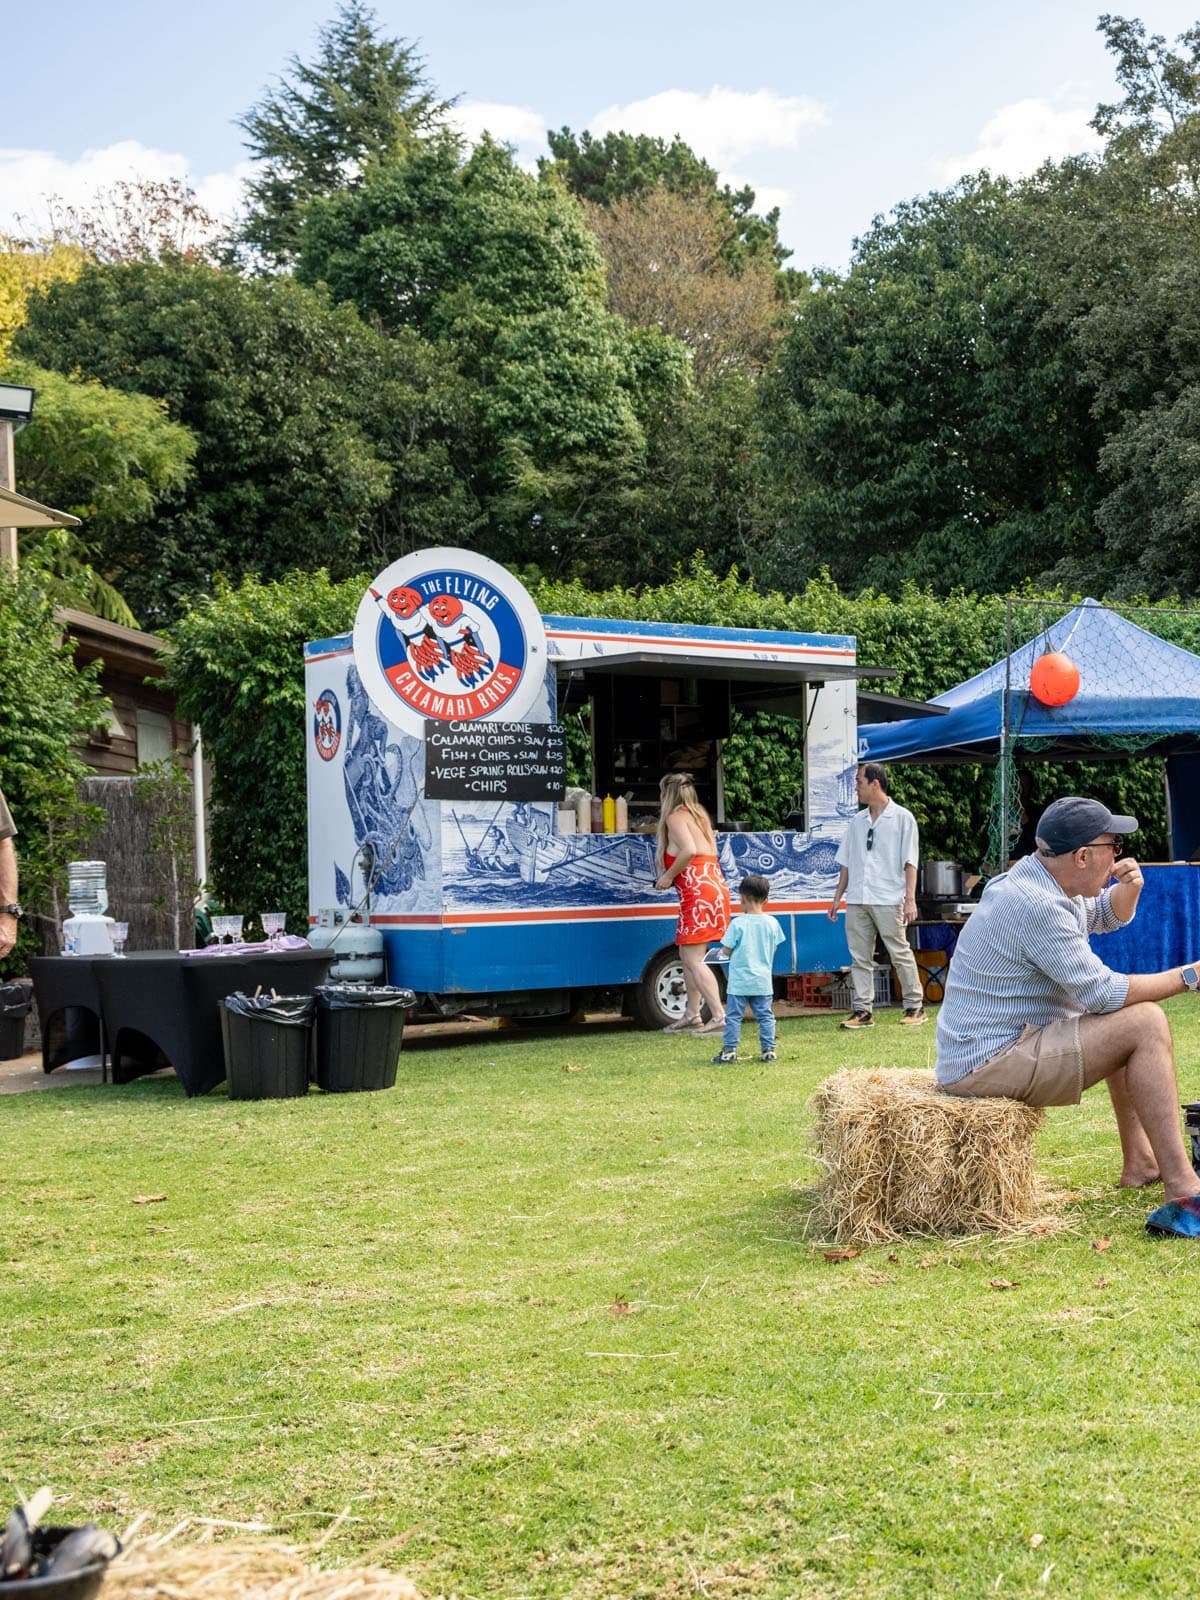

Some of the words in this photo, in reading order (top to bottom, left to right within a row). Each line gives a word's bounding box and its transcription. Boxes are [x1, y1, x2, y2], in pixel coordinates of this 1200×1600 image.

[421, 579, 442, 595] THE
[445, 576, 499, 610] FLYING
[395, 672, 474, 716] CALAMARI
[477, 672, 516, 709] BROS.
[449, 720, 498, 734] CALAMARI
[502, 721, 532, 734] CONE
[431, 734, 485, 746] CALAMARI
[487, 735, 515, 745] CHIPS
[441, 748, 468, 760] FISH
[478, 749, 510, 761] CHIPS
[435, 766, 466, 779] VEGE
[469, 765, 504, 777] SPRING
[471, 780, 507, 793] CHIPS
